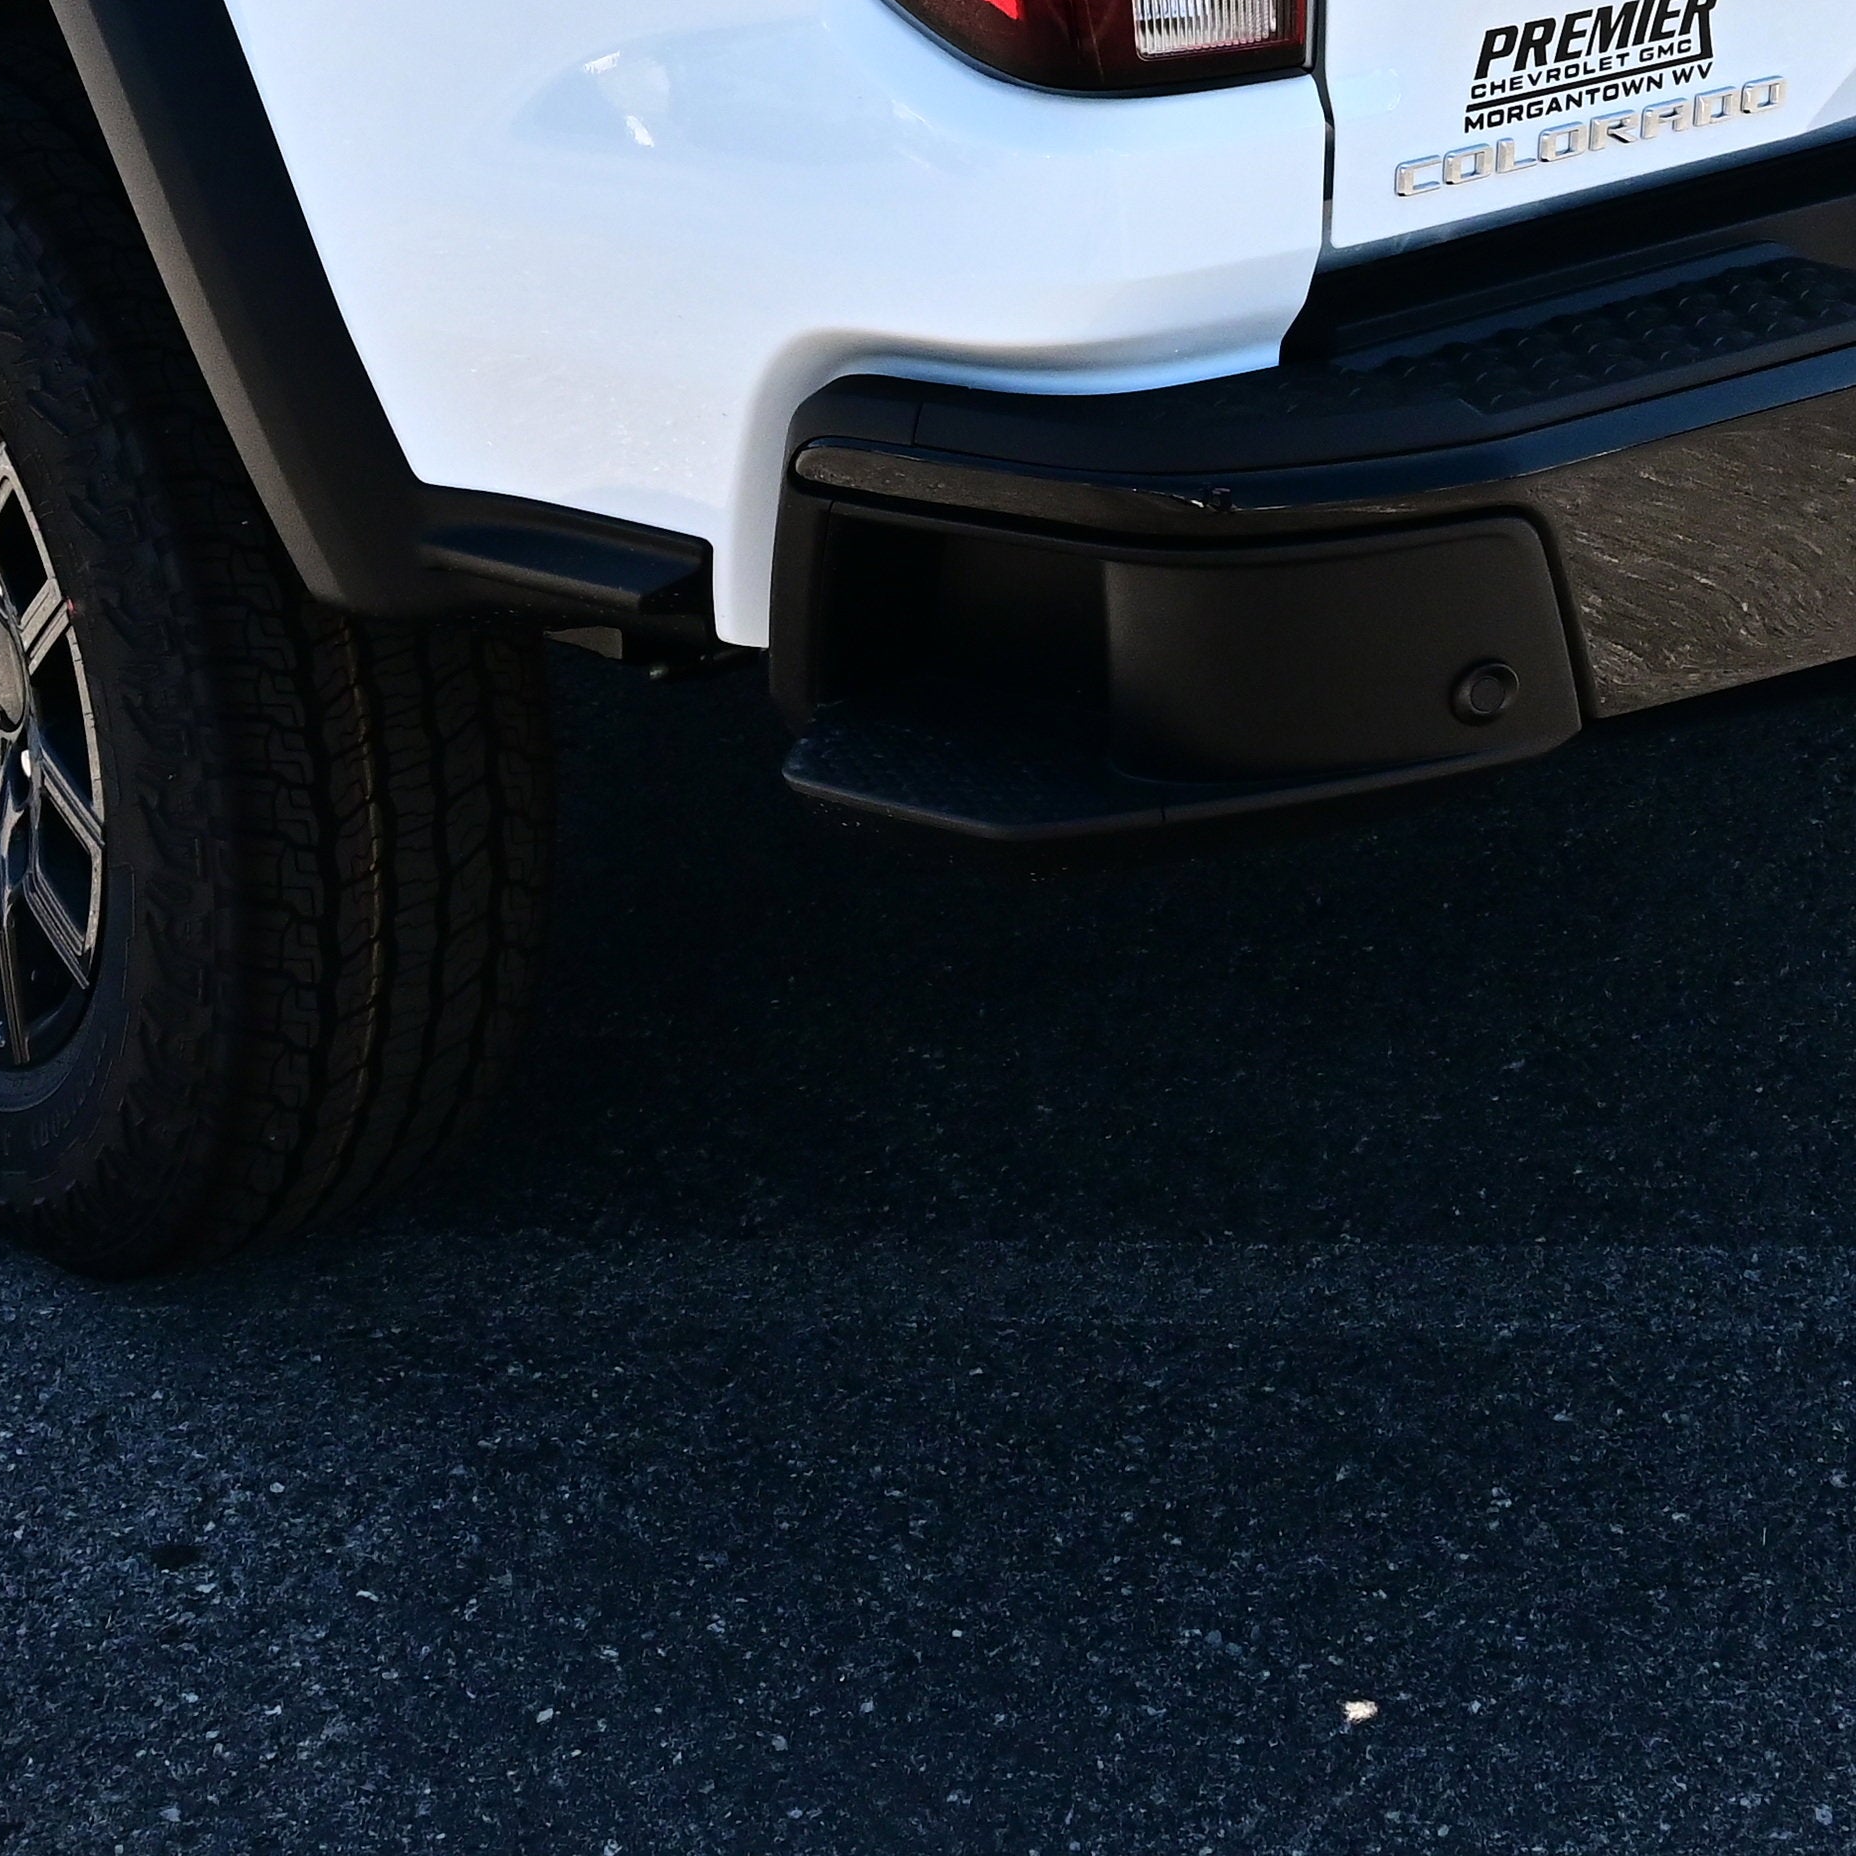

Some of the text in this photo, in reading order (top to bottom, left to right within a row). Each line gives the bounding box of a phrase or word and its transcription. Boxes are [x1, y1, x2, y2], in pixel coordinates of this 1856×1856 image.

[1464, 62, 1714, 134] MORGANTOWN WV
[1471, 39, 1692, 99] CHEVROLET GMC
[1394, 75, 1787, 196] COLORADO
